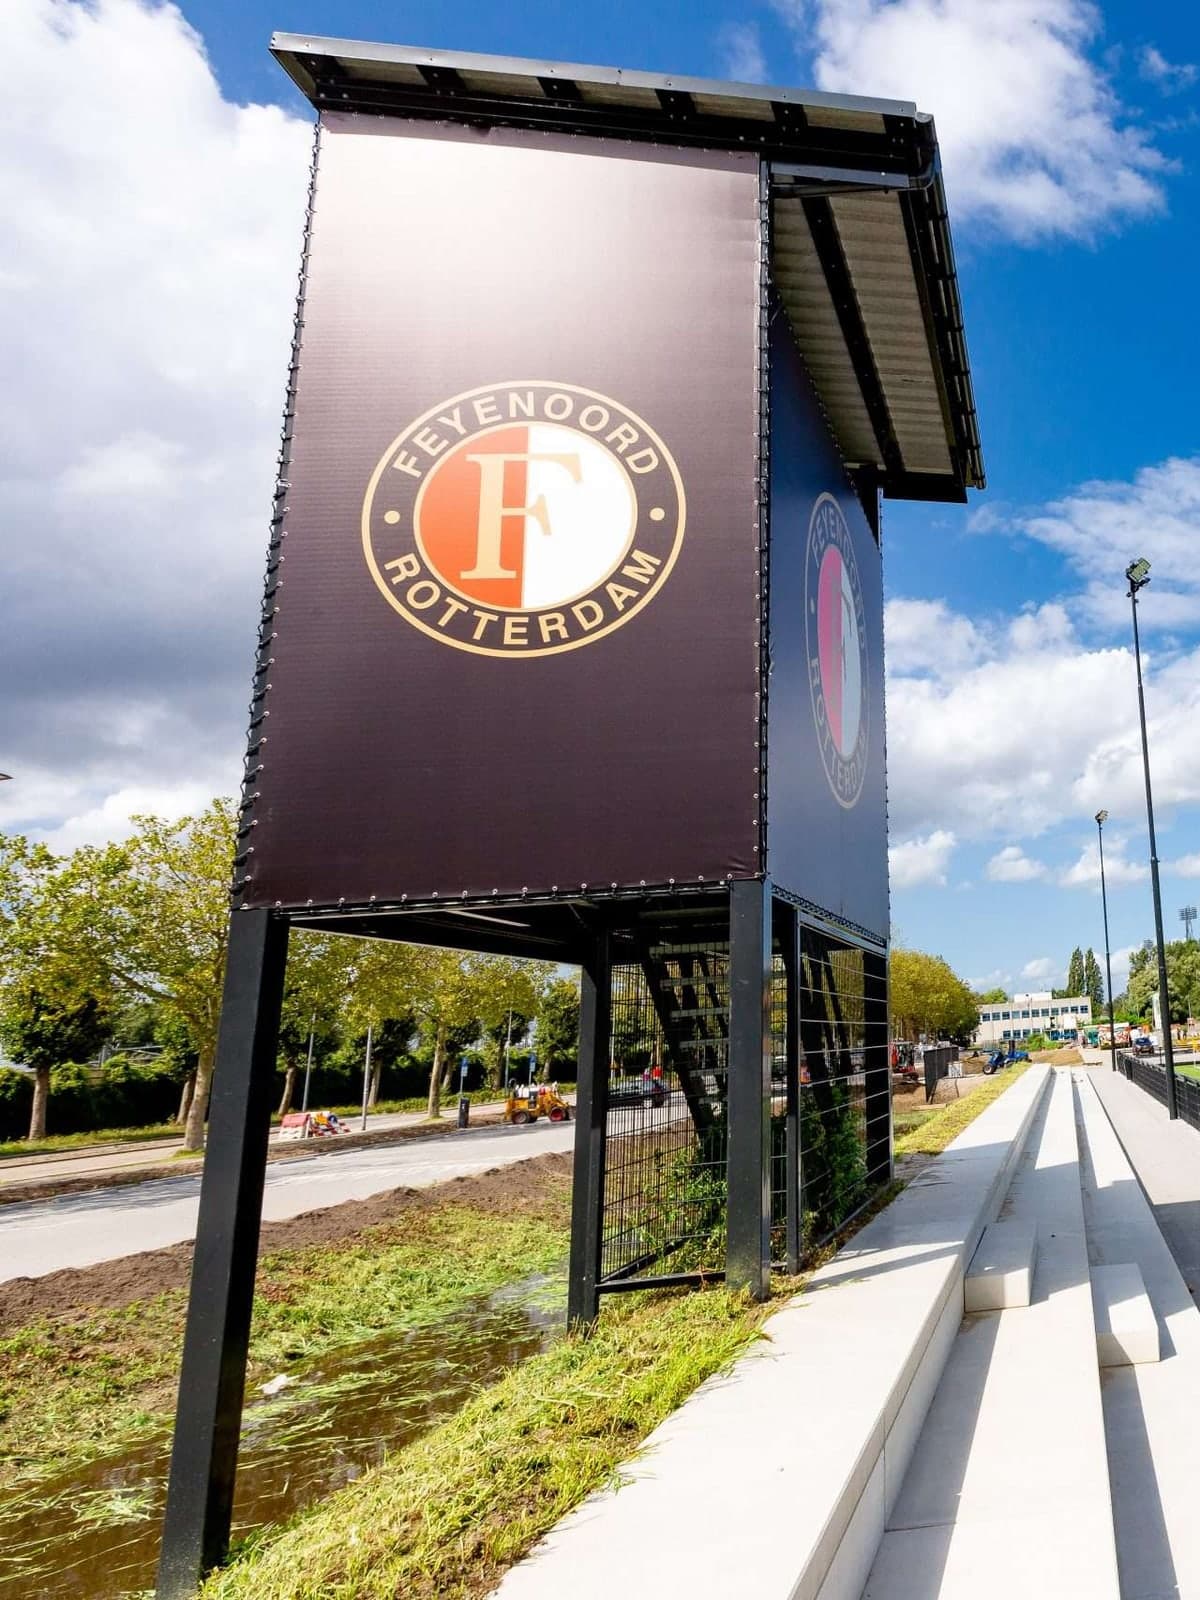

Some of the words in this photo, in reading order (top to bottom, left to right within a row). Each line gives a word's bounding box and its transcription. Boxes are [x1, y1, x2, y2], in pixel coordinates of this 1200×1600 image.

[392, 391, 659, 478] FEYENOORD
[460, 452, 583, 580] F
[383, 549, 662, 646] ROTTERDAM
